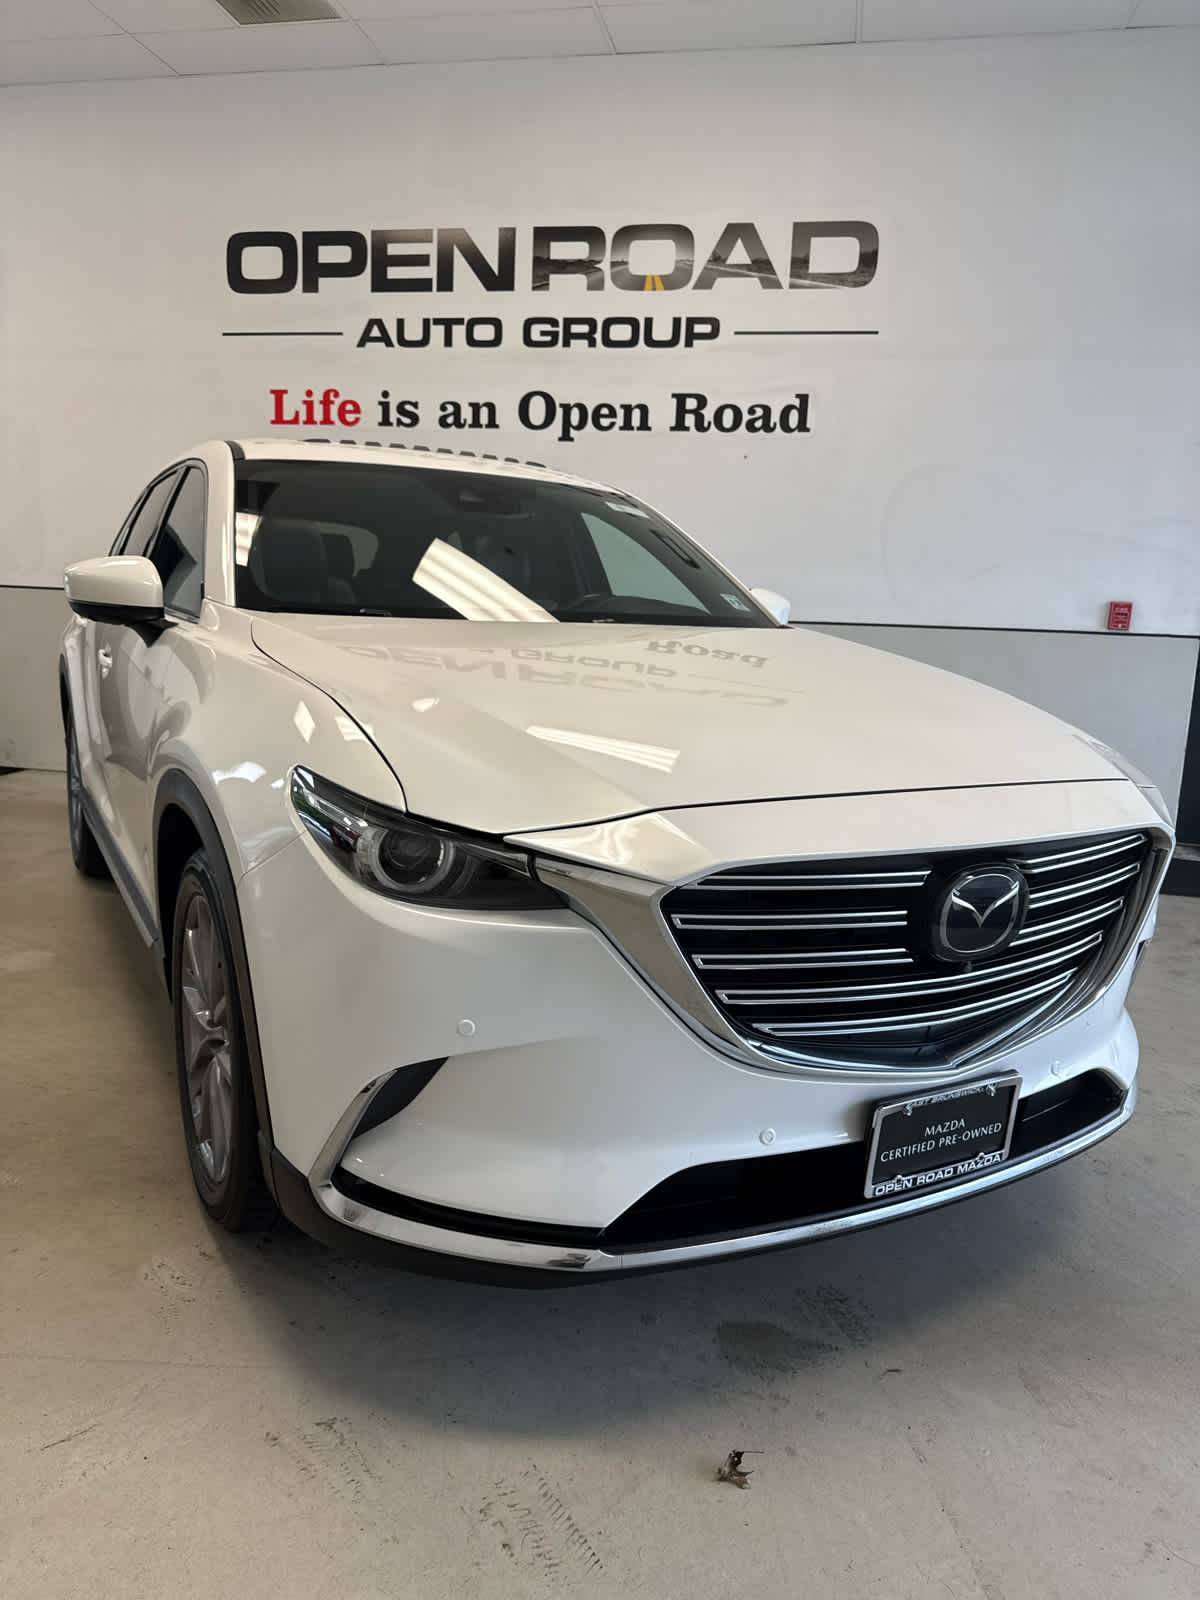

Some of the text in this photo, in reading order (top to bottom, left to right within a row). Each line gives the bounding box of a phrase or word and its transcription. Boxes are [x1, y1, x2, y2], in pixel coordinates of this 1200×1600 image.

[226, 221, 880, 294] OPEN ROAD
[356, 316, 721, 349] AUTO GROUP
[270, 388, 811, 443] Life is an Open Road
[880, 1122, 1002, 1162] CERTIFIED PRE-OWNED
[924, 1118, 966, 1137] MAZDA
[875, 1154, 1001, 1196] OPEN ROAD MAZDA
